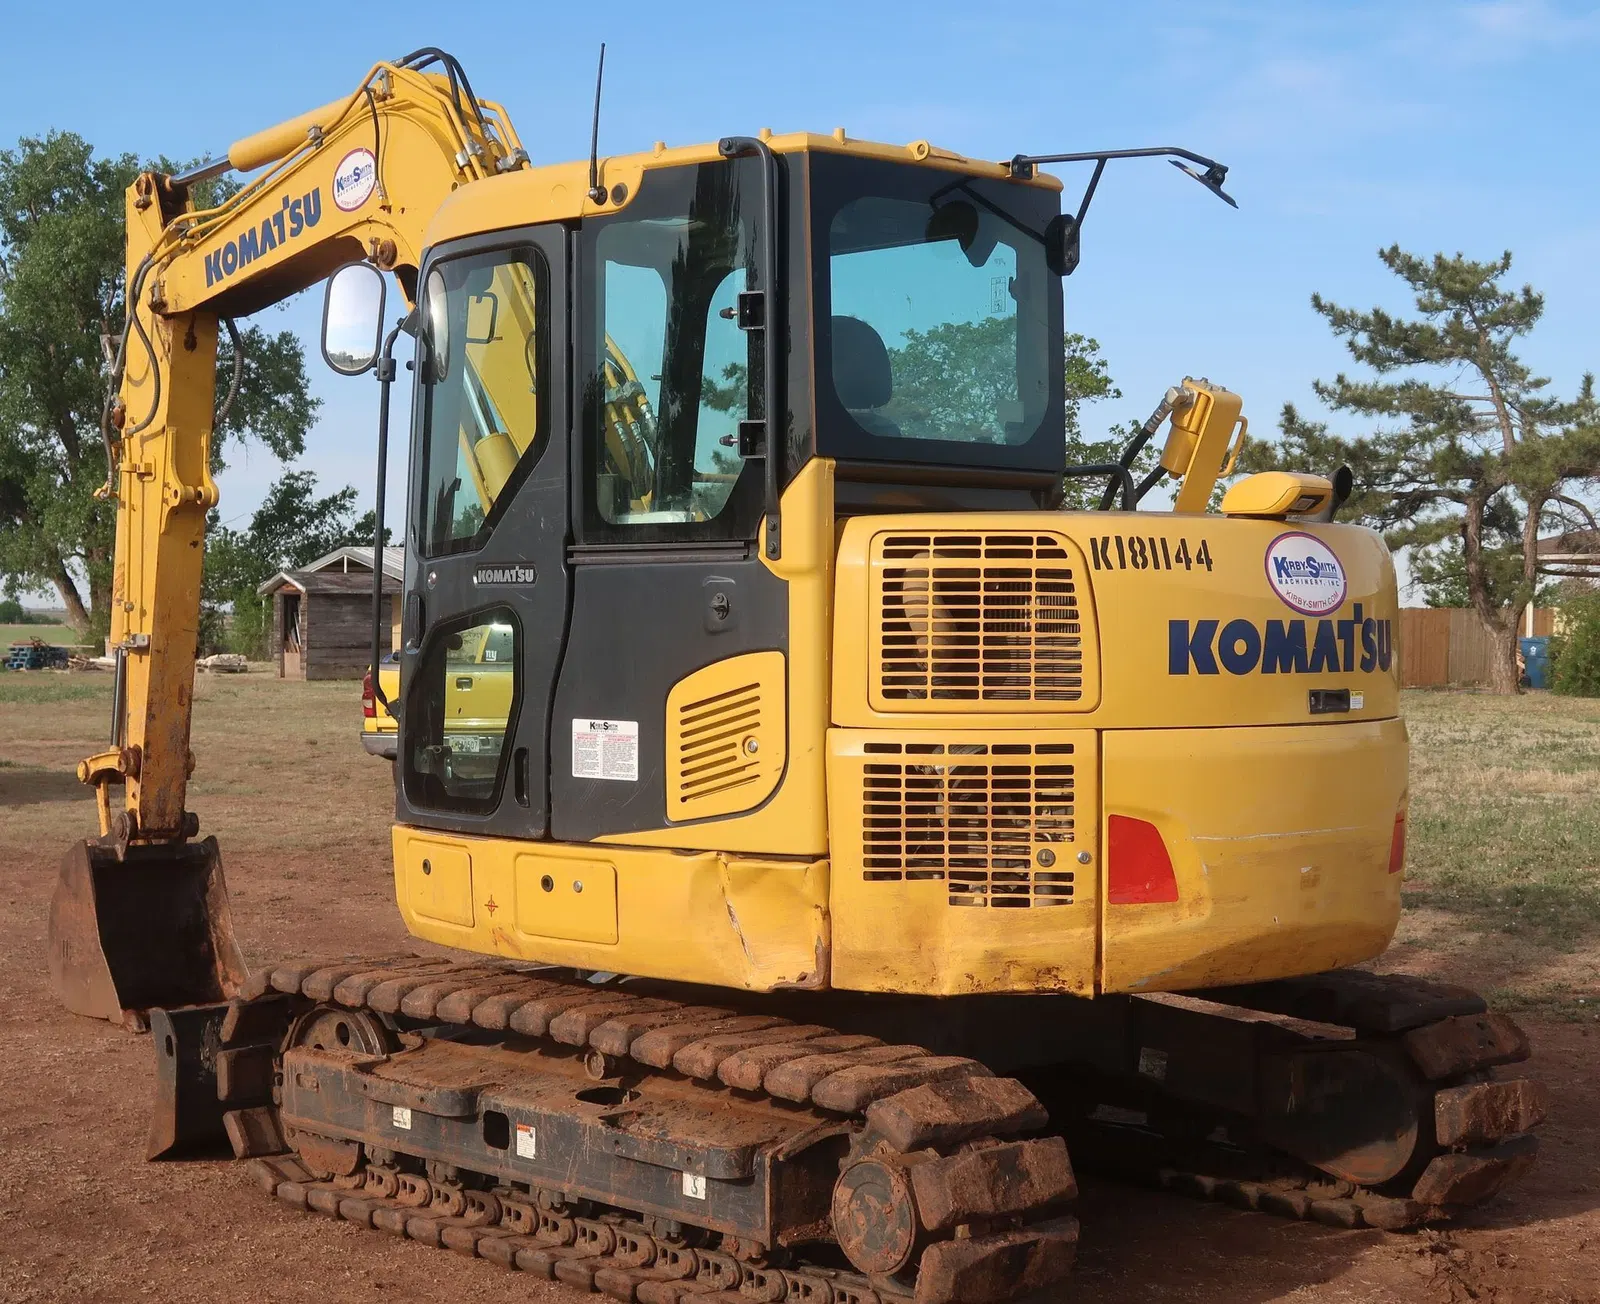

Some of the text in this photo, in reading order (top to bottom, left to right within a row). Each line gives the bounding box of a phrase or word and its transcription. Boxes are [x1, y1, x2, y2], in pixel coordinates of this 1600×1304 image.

[204, 187, 322, 289] KOMATSU
[1090, 535, 1213, 572] K181144
[1273, 556, 1337, 578] KIRBY-SMITH
[477, 565, 534, 583] KOMATSU
[1286, 590, 1340, 609] KIRBY-SMITH.COM
[1168, 603, 1391, 676] KOMATSU
